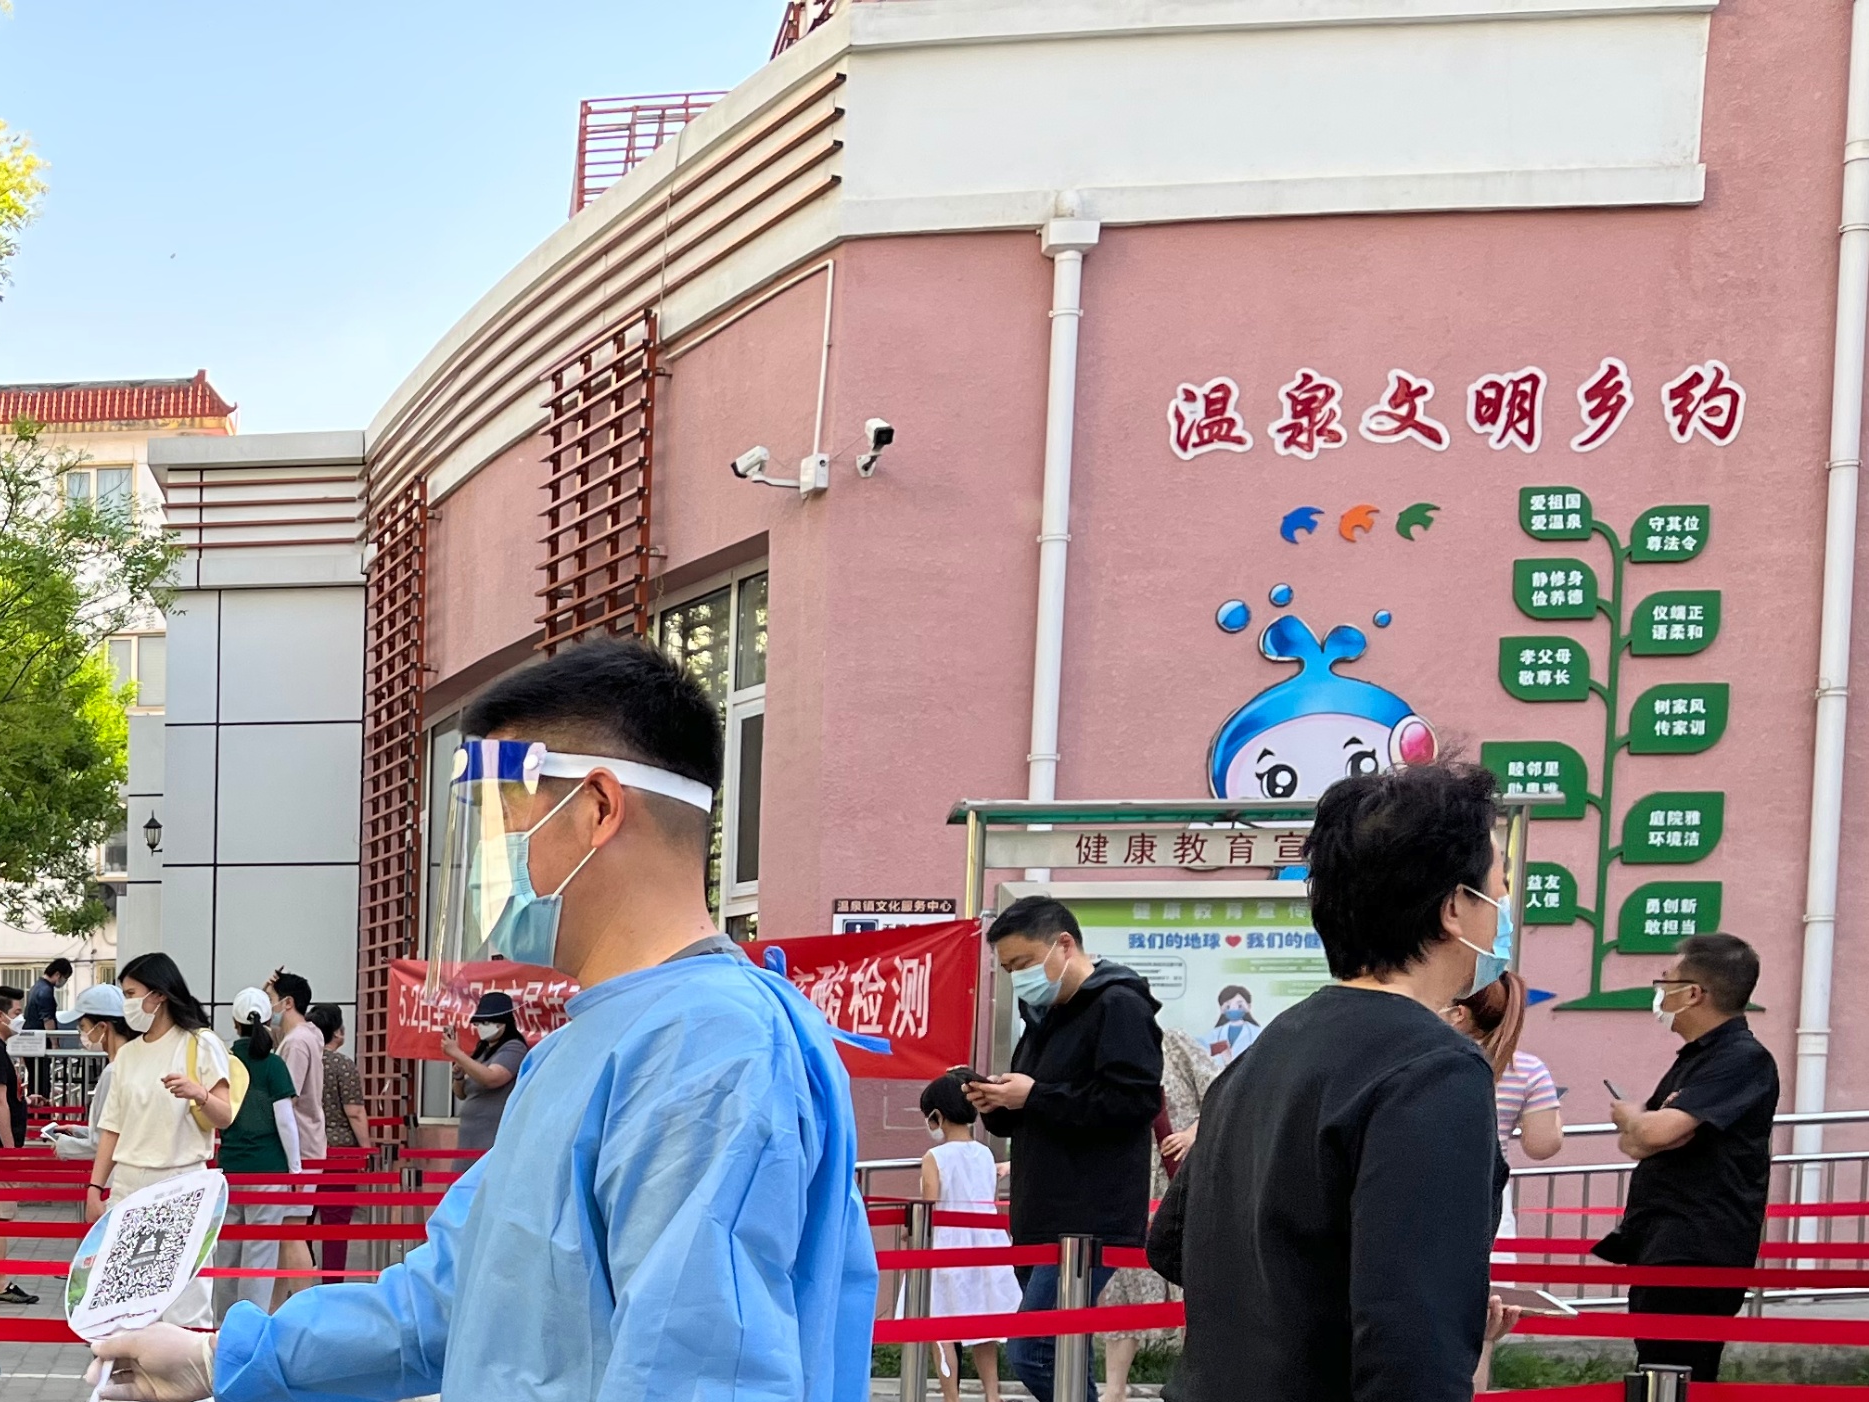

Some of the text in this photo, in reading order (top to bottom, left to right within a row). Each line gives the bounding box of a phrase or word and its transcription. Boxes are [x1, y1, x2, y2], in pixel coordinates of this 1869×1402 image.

[1171, 360, 1740, 455] 温泉文明乡约
[1530, 494, 1581, 511] 爱祖国
[1531, 514, 1582, 530] 爱温泉
[1649, 516, 1700, 532] 守其位
[1646, 536, 1698, 552] 尊法令
[1532, 570, 1583, 587] 静修身
[1652, 605, 1704, 621] 仪端正
[1652, 624, 1703, 640] 语柔和
[1520, 649, 1571, 665] 孝父母
[1518, 669, 1570, 686] 敬尊长
[1654, 698, 1706, 715] 树家风
[1654, 720, 1706, 736] 传家训
[1508, 761, 1560, 777] 睦邻里
[1649, 811, 1701, 827] 庭院雅
[1648, 831, 1700, 847] 环境洁
[1076, 833, 1306, 866] 健康教育宣
[1526, 874, 1561, 891] 益友
[837, 900, 952, 912] 温泉镇文化服务中心
[1526, 893, 1560, 908] 人便
[1646, 898, 1698, 914] 勇创新
[1644, 919, 1696, 936] 敢担当
[1129, 932, 1220, 949] 我们的地球
